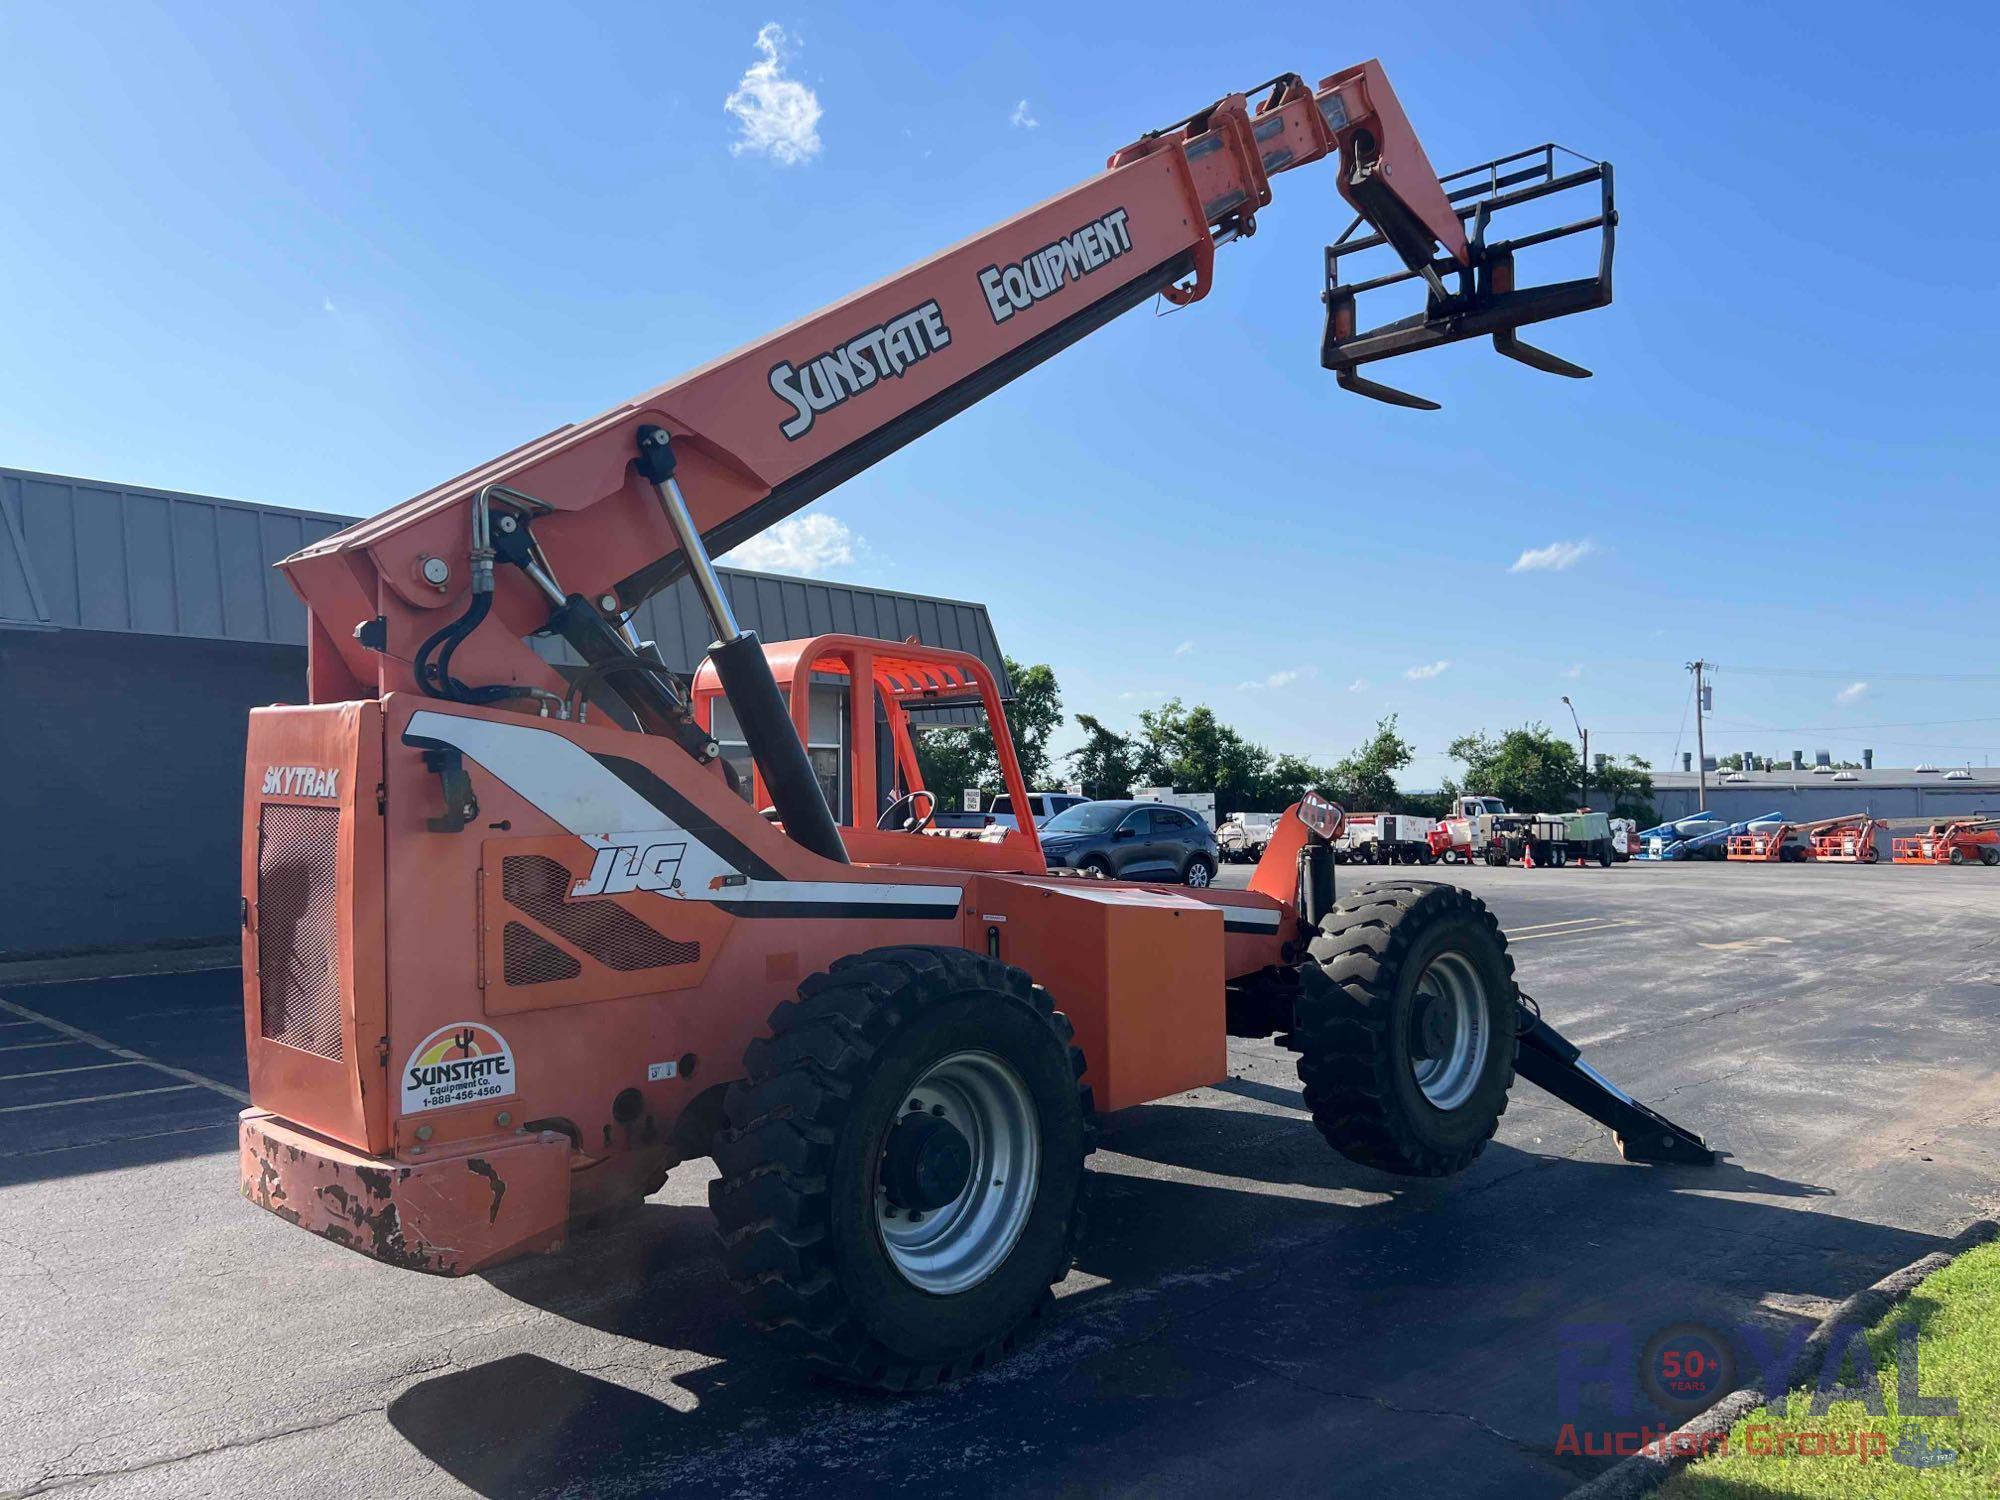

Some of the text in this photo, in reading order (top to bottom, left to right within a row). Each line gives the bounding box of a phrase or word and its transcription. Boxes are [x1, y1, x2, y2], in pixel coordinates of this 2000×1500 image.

[768, 207, 1134, 441] SUNSTATE EQUIPMENT
[261, 766, 339, 798] SKYTRAK
[570, 842, 687, 898] JLG
[407, 1056, 510, 1091] SUNSTATE
[430, 1077, 490, 1096] Equipment Co.
[423, 1085, 502, 1107] 1-888-456-4560
